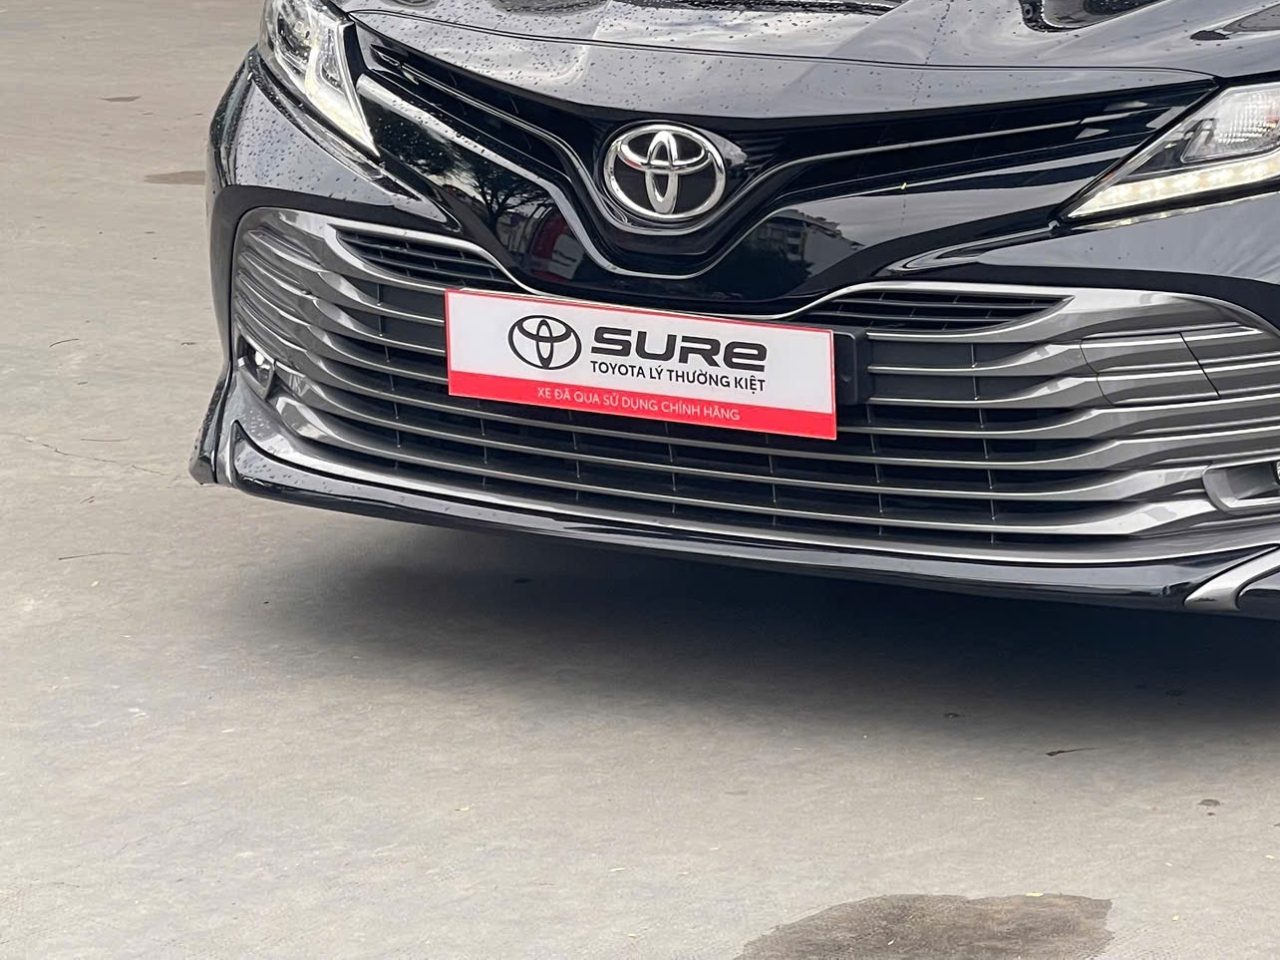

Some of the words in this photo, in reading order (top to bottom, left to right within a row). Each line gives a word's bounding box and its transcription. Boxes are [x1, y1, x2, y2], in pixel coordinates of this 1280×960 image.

[590, 361, 645, 379] TOYOTA
[649, 365, 664, 381] LÝ
[666, 369, 730, 388] THƯỜNG
[734, 375, 766, 394] KIỆT
[537, 387, 551, 399] XE
[573, 391, 601, 404] QUA
[603, 392, 620, 407] SỬ
[622, 396, 658, 411] DỤNG
[661, 399, 700, 416] CHÍNH
